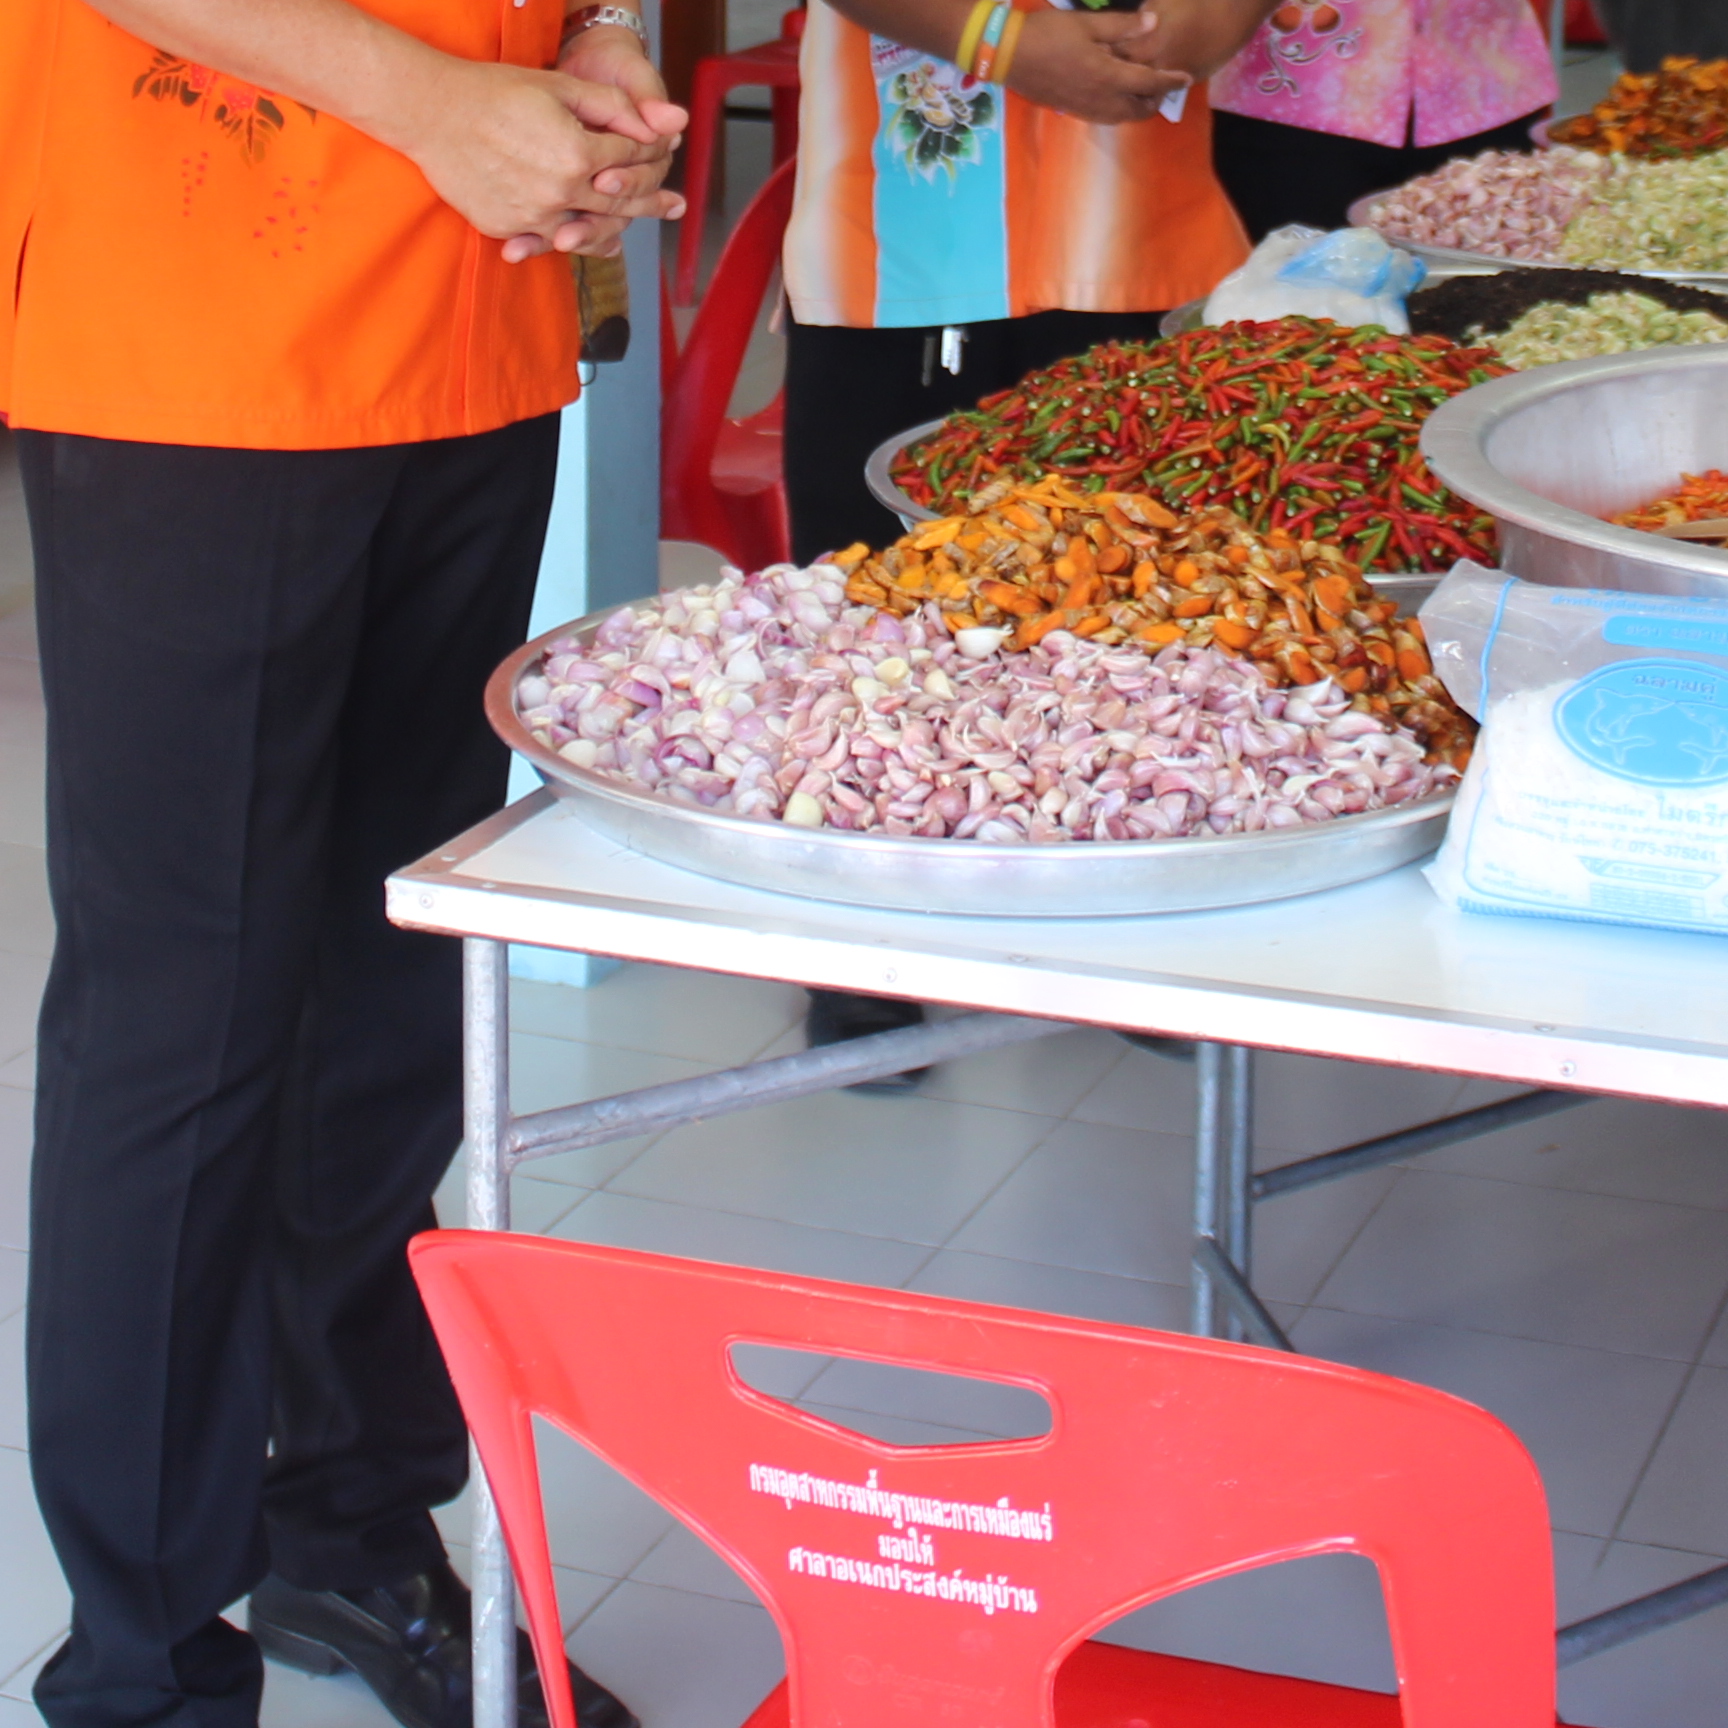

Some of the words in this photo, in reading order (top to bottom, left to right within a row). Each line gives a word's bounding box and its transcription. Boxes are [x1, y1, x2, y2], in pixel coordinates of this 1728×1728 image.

[749, 1463, 1053, 1542] กรมอุตสาหกรรมพื้นฐานและการเหมืองแร่
[788, 1546, 1038, 1616] ศาลาอเนกประสงค์หมู่บ้าน
[877, 1527, 935, 1567] มอบให้
